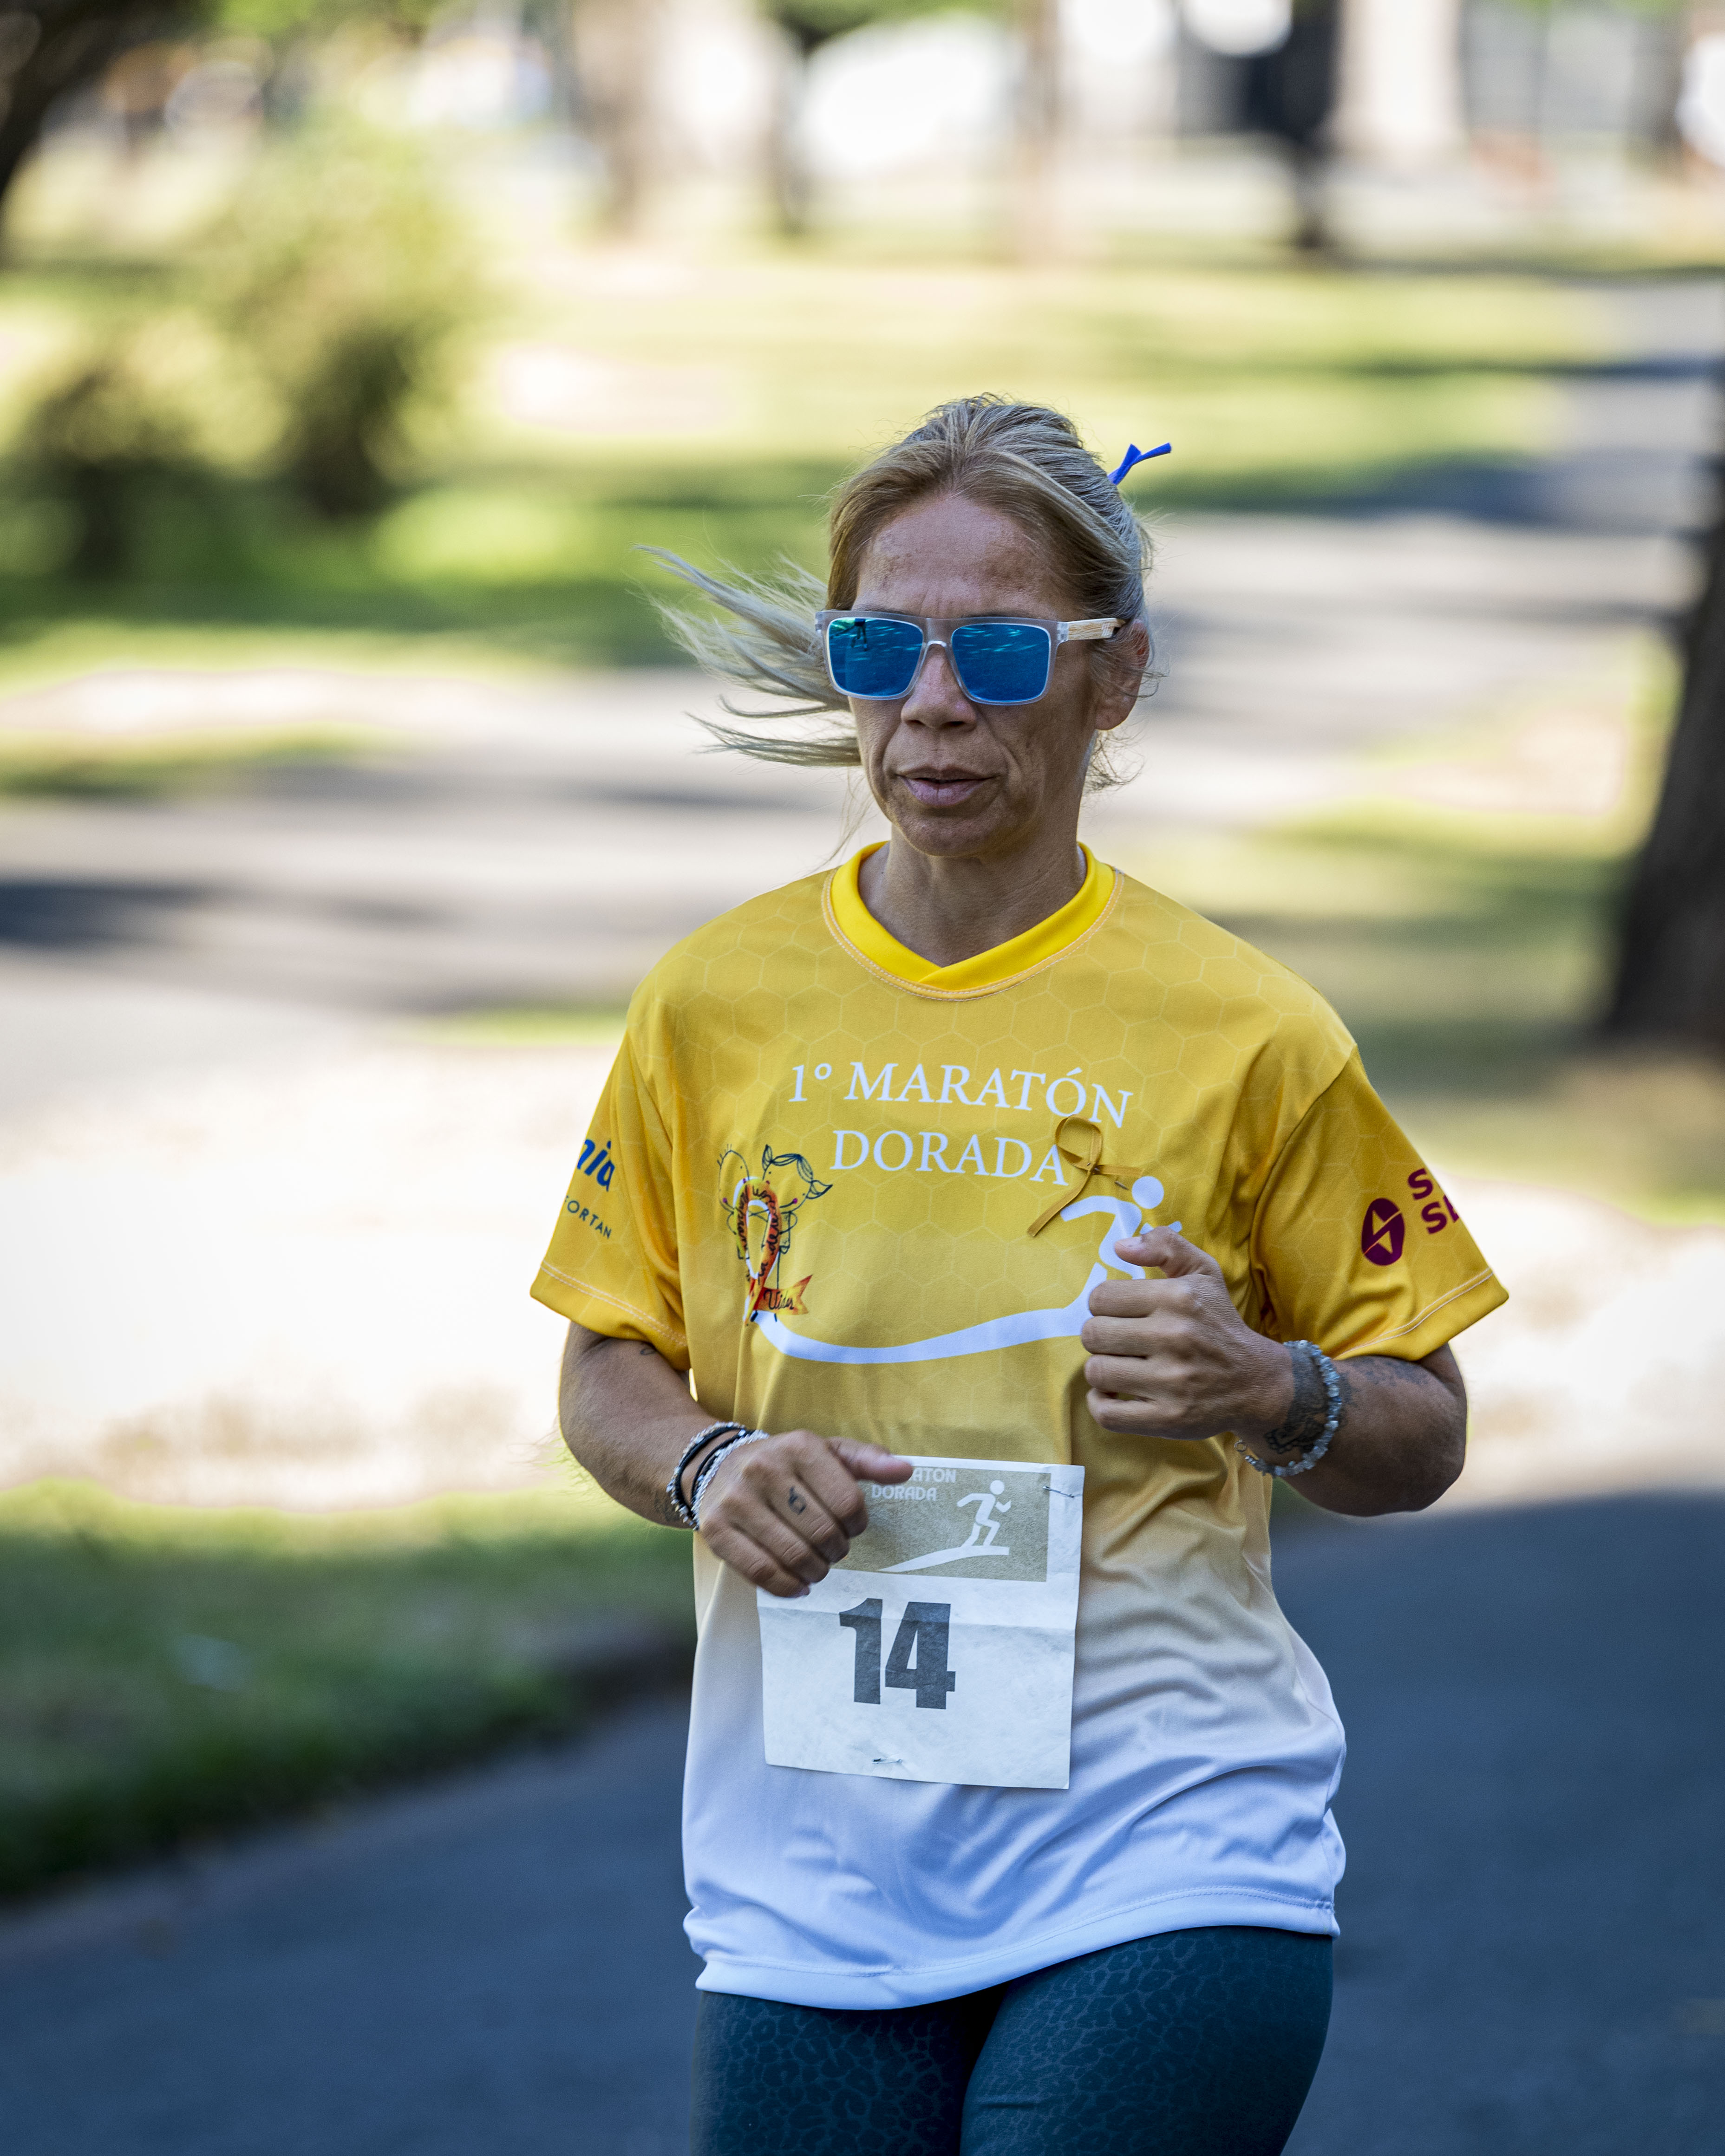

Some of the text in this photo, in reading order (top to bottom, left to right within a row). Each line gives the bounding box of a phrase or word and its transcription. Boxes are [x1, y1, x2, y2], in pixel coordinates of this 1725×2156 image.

[844, 1062, 1133, 1128] MARATÓN
[829, 1129, 1069, 1186] DORADA
[565, 1195, 613, 1239] ORTAN
[871, 1484, 937, 1501] DORADA
[839, 1598, 956, 1710] 14
